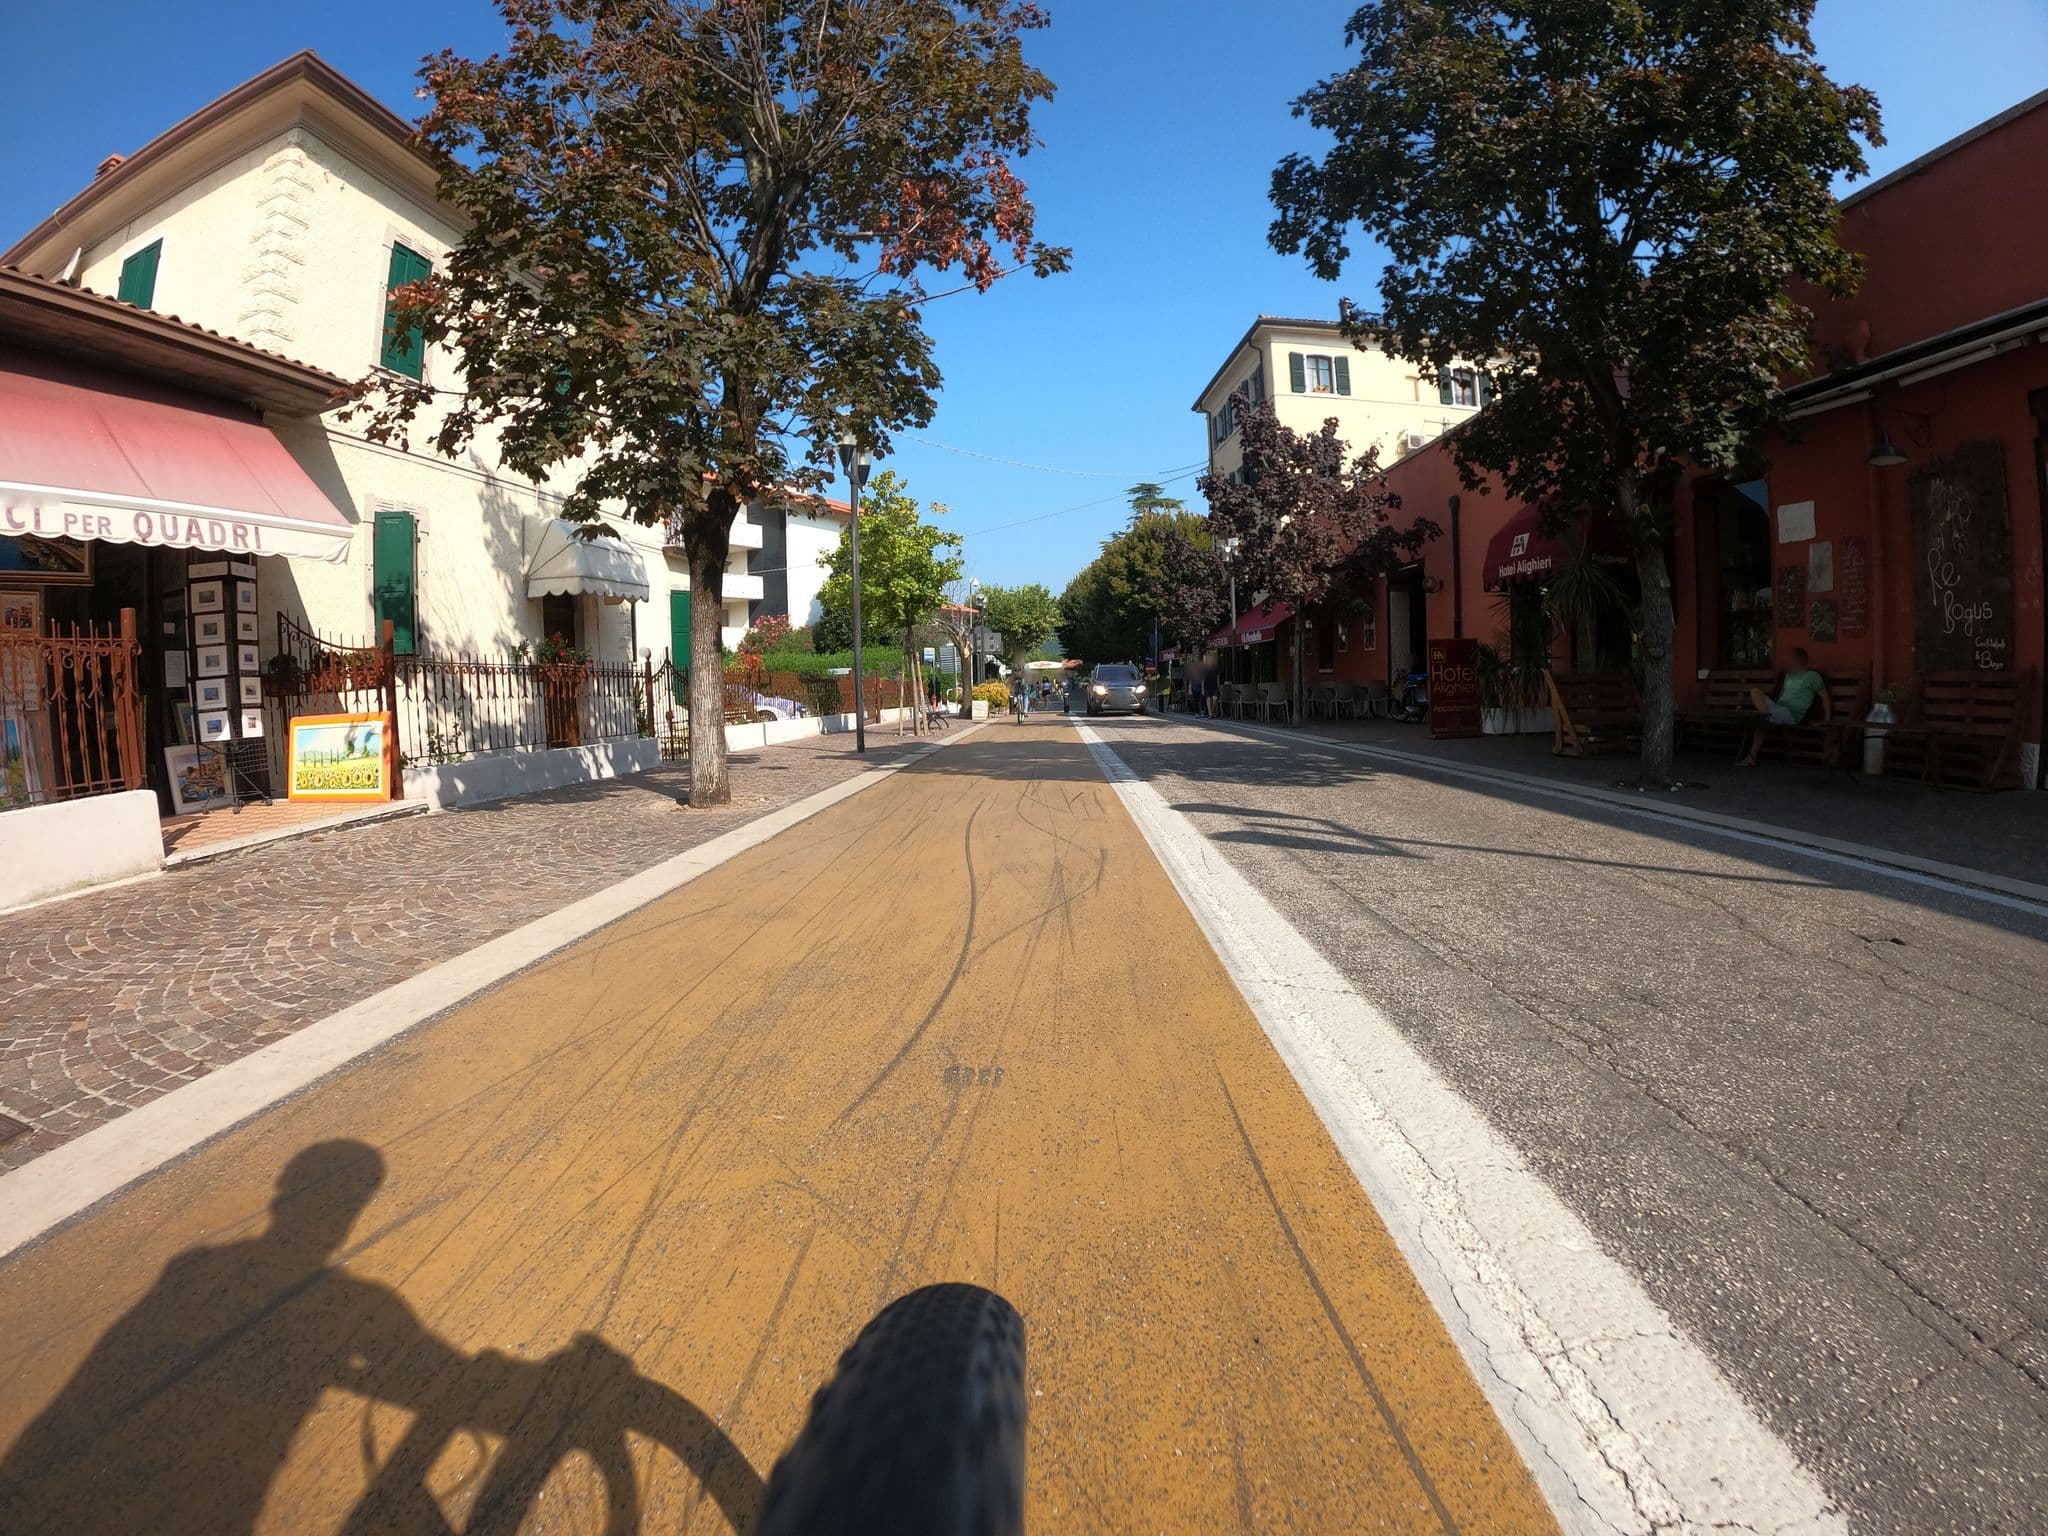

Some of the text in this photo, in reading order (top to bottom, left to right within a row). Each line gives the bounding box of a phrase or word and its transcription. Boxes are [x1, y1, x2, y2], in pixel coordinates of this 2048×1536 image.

[64, 512, 112, 535] PER
[133, 511, 262, 550] QUADRI
[1498, 555, 1552, 578] Hotel Alighieri
